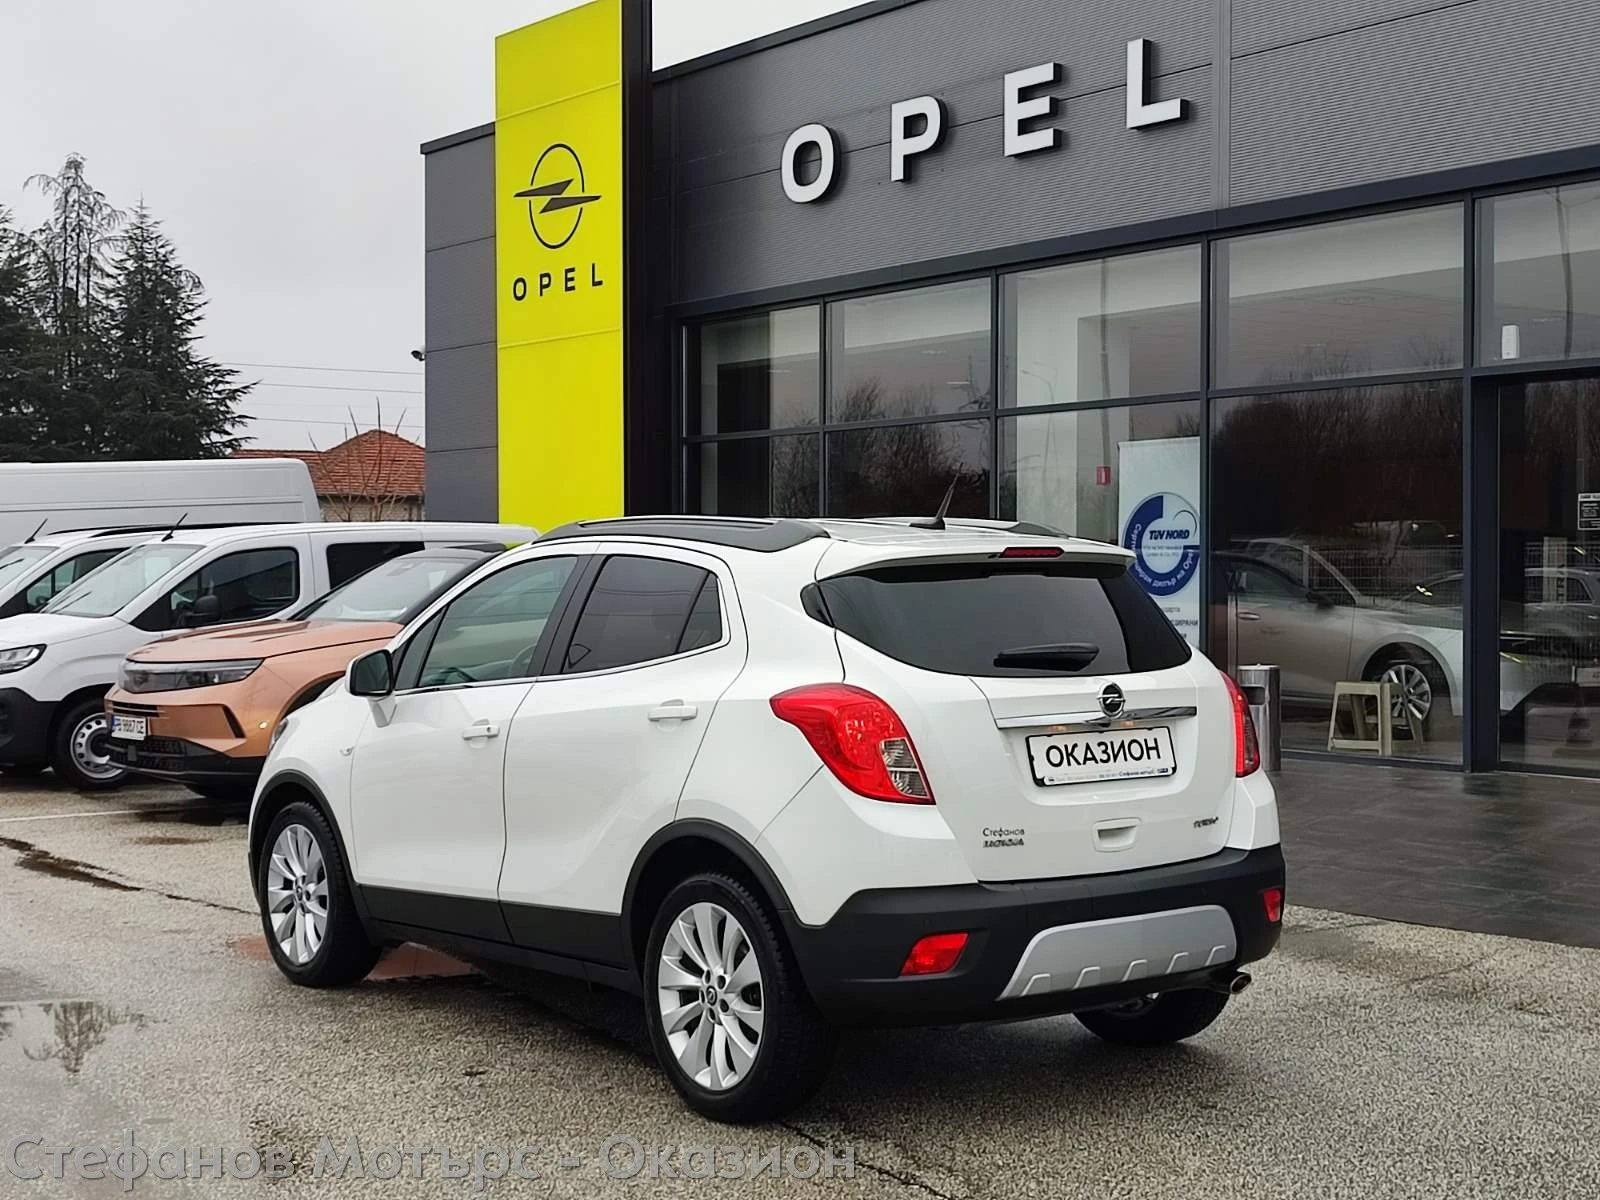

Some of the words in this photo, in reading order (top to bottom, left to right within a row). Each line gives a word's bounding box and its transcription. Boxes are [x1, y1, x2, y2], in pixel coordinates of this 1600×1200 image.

[781, 38, 1187, 205] OPEL
[513, 263, 604, 301] OPEL
[1165, 529, 1190, 540] NORD
[1046, 737, 1161, 767] ОКАЗИОН
